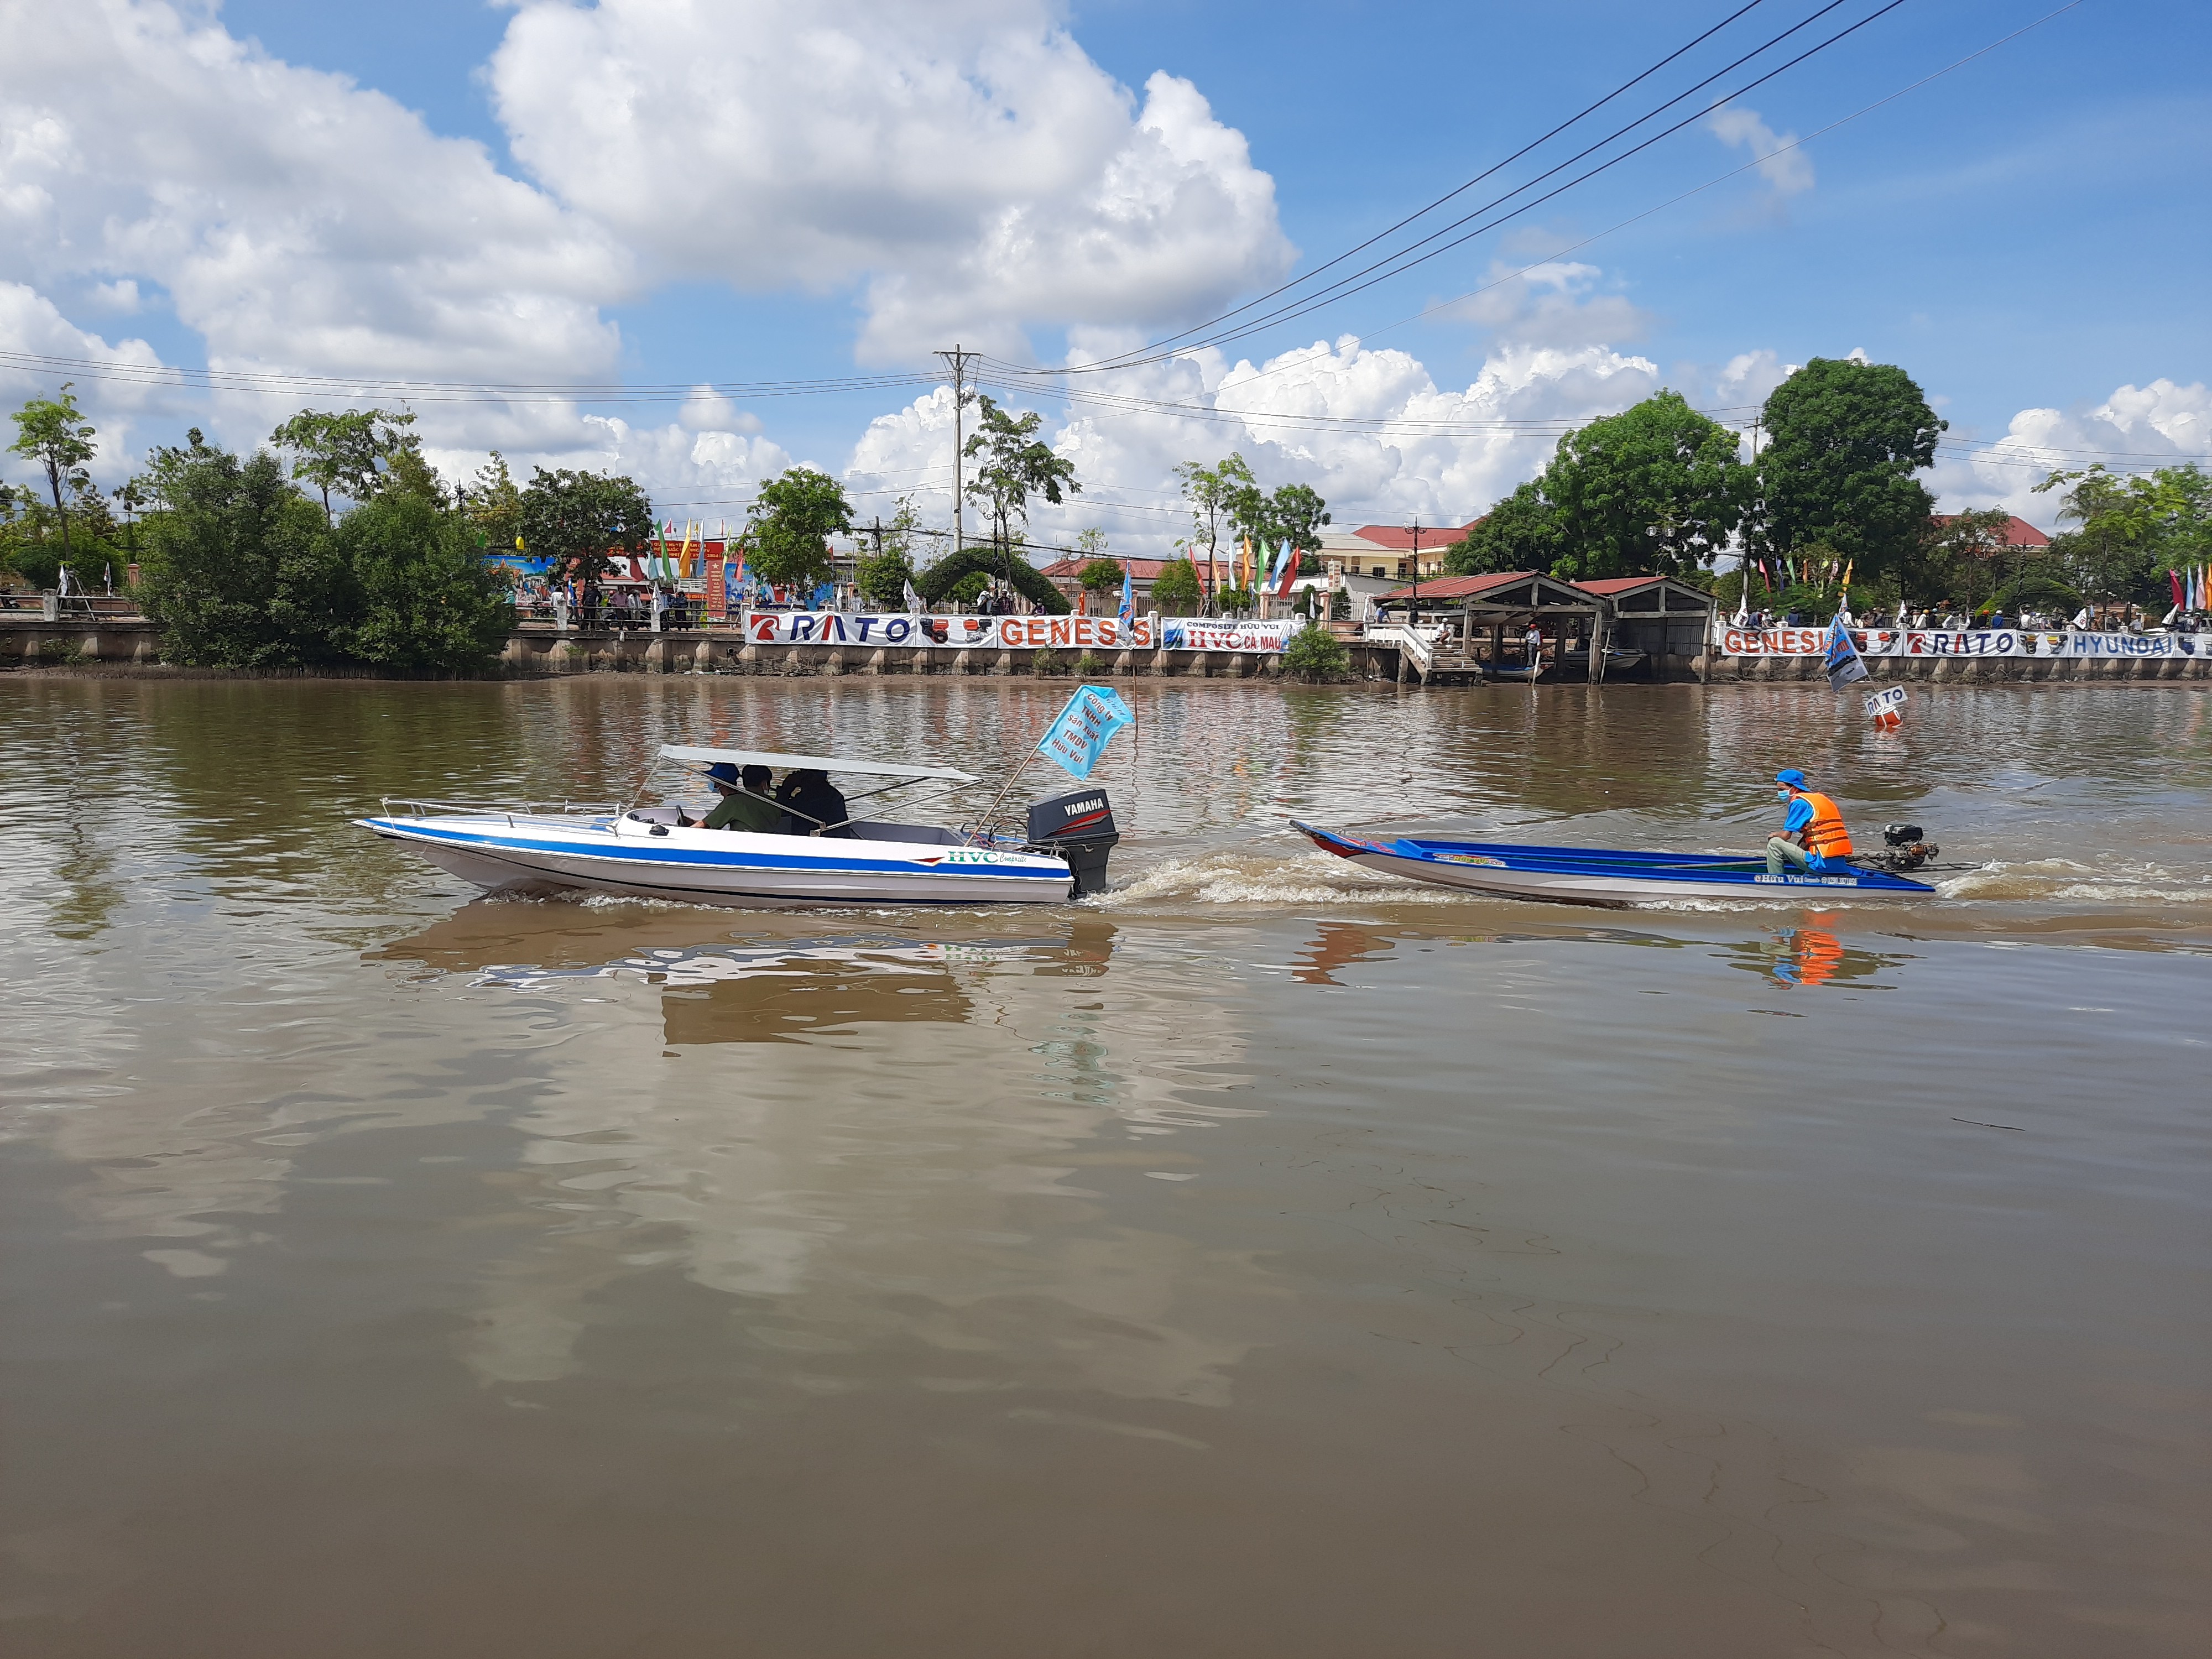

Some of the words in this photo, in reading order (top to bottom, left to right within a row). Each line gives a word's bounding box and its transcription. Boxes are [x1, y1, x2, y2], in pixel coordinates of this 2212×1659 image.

[790, 615, 910, 643] RATO
[1000, 619, 1150, 646] GENESS
[1188, 630, 1241, 649] HVC
[1244, 632, 1257, 649] CÀ
[1260, 636, 1281, 650] MAU
[1725, 630, 1823, 654] GENESI
[1932, 633, 2013, 654] RATO
[2074, 636, 2172, 654] HYUNDAI
[1087, 693, 1105, 713] Công
[1105, 710, 1113, 721] ty
[1867, 689, 1902, 714] RATO
[1081, 705, 1101, 727] TNHH
[1067, 714, 1083, 727] sản
[1083, 725, 1100, 742] xuất
[1063, 729, 1089, 750] TMDV
[1070, 749, 1084, 764] Vui
[1064, 797, 1104, 816] YAMAHA
[948, 851, 999, 863] HVC
[1000, 853, 1027, 863] Composite
